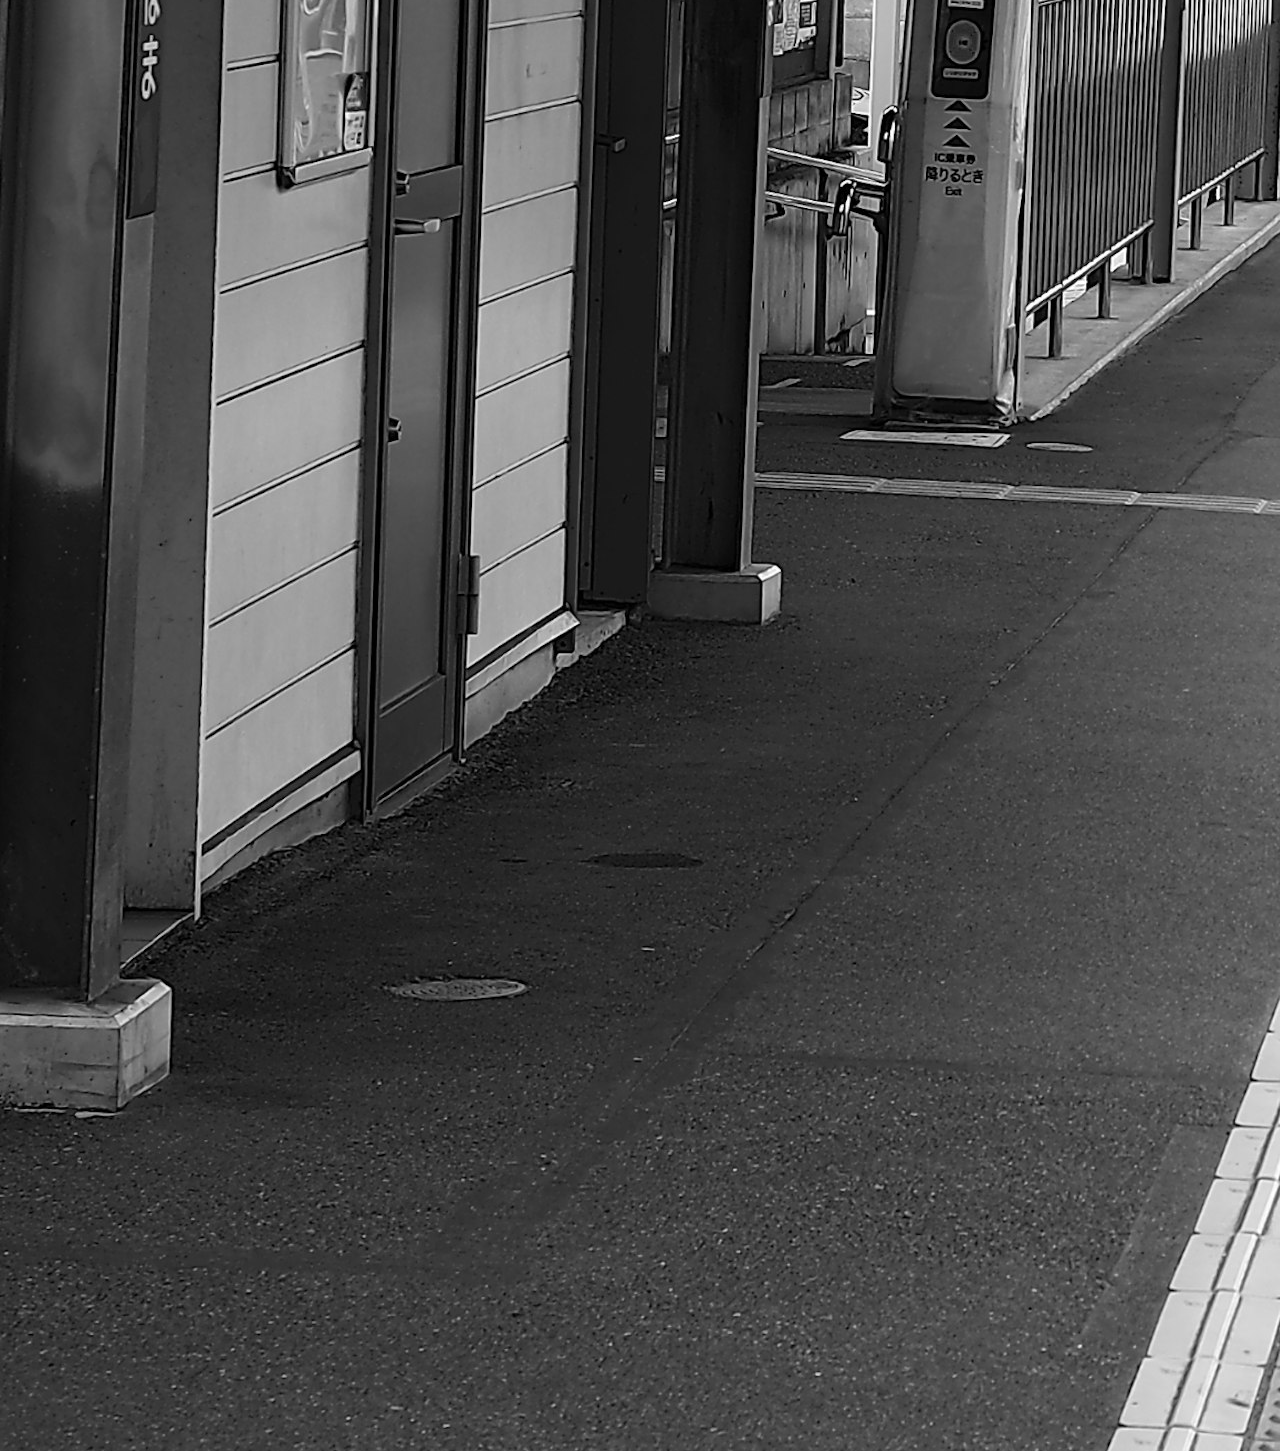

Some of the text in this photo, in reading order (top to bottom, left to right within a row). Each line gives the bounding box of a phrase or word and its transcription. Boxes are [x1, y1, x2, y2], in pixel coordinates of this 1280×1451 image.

[934, 152, 976, 164] IC乗車券
[925, 167, 984, 183] 降りるとき
[945, 185, 962, 197] Exit
